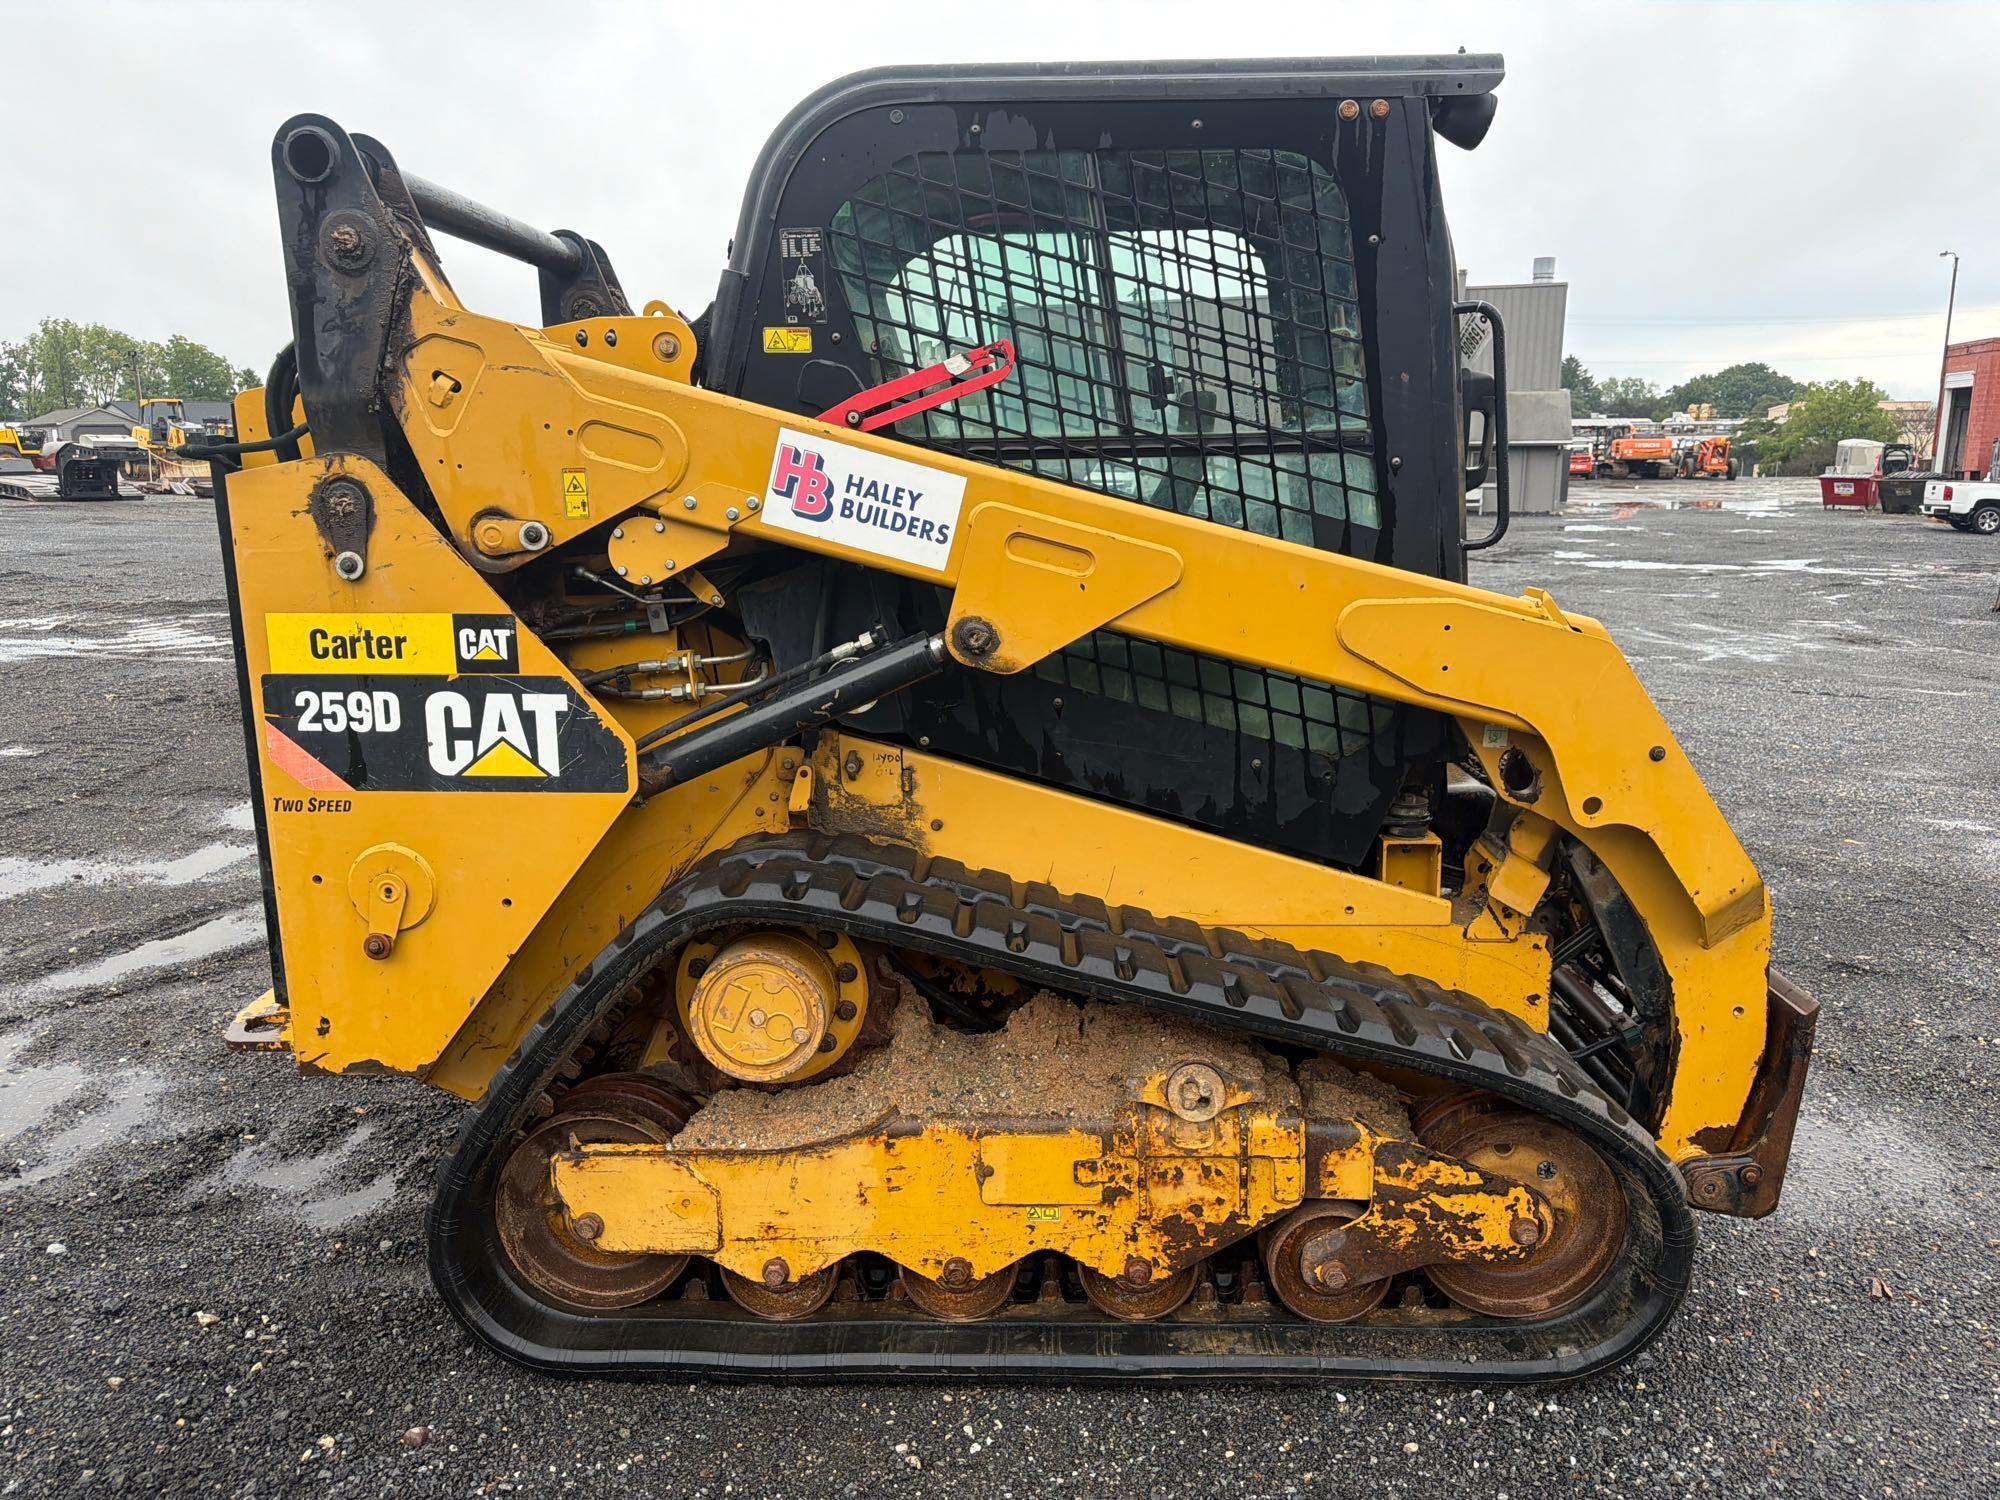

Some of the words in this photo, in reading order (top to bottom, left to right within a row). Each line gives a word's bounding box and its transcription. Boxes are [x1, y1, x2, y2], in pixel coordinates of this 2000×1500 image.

[845, 473, 924, 511] HALEY
[840, 498, 950, 545] BUILDERS
[309, 628, 407, 660] Carter
[458, 628, 511, 661] CAT
[294, 690, 401, 733] 259D
[424, 690, 569, 777] CAT
